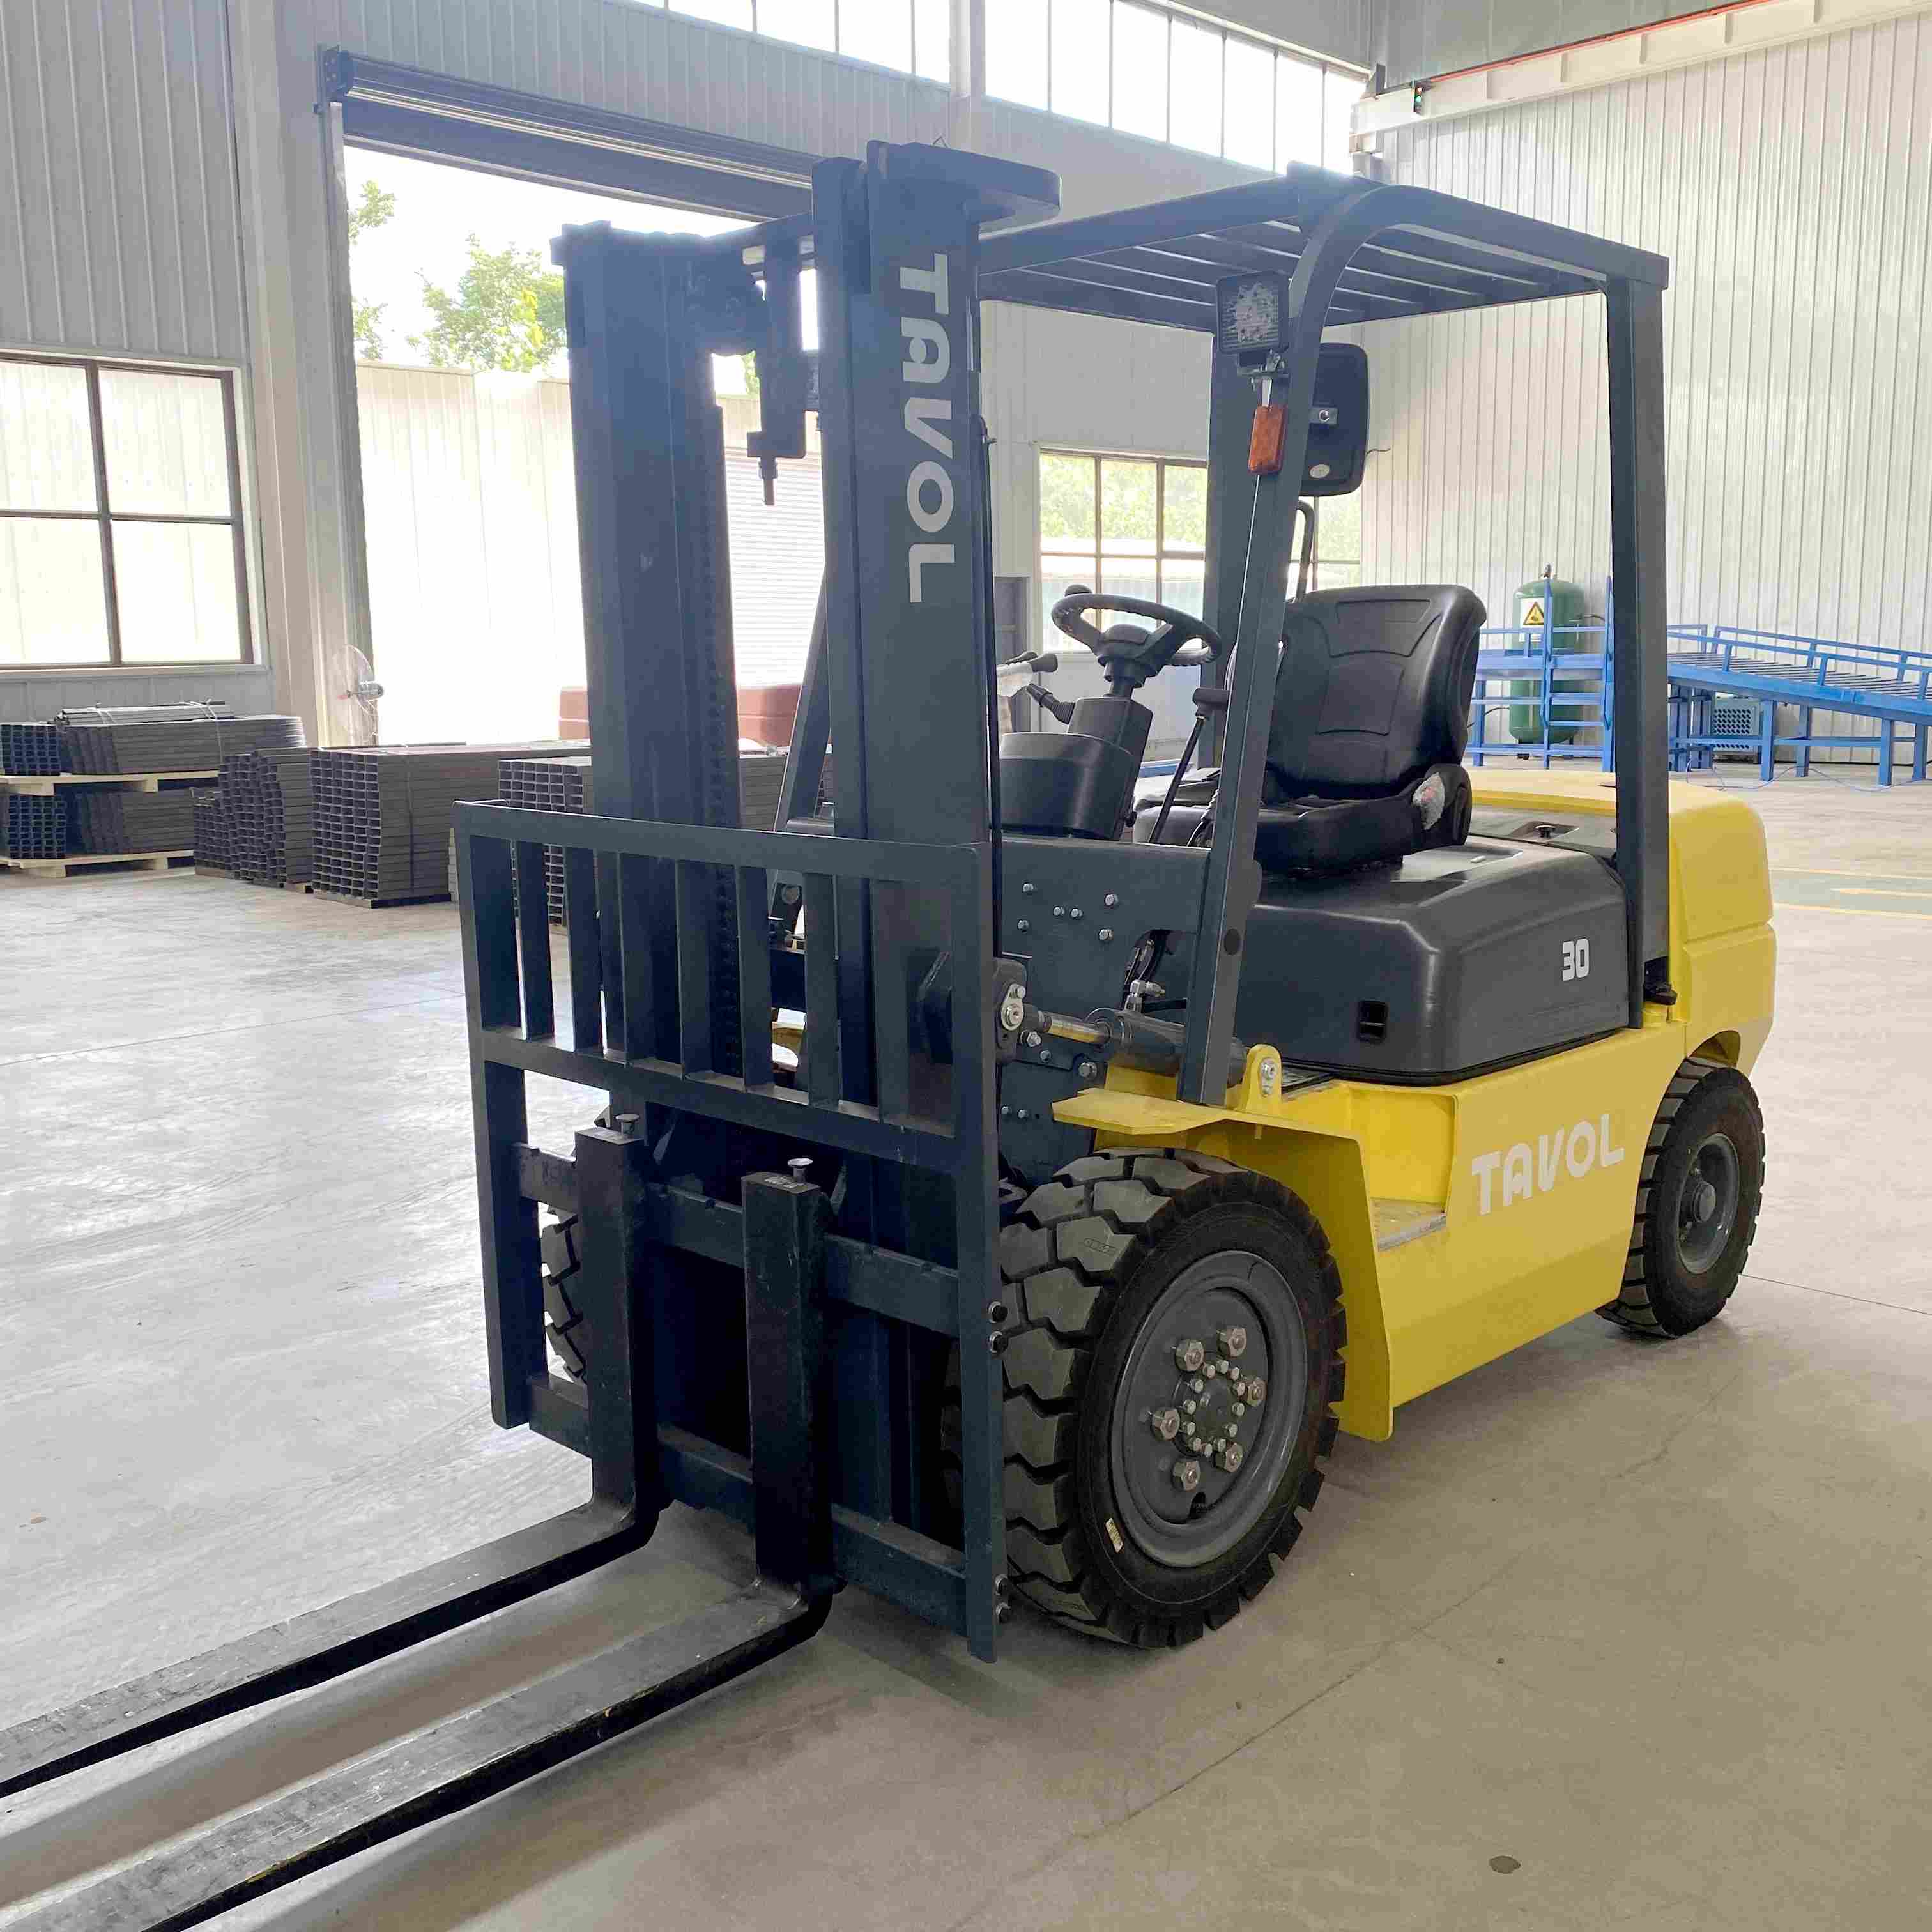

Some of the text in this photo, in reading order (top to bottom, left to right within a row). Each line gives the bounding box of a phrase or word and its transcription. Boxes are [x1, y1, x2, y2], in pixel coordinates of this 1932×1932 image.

[900, 253, 955, 602] TAVOL
[1562, 938, 1590, 981] 30
[1471, 1114, 1625, 1215] TAVOL
